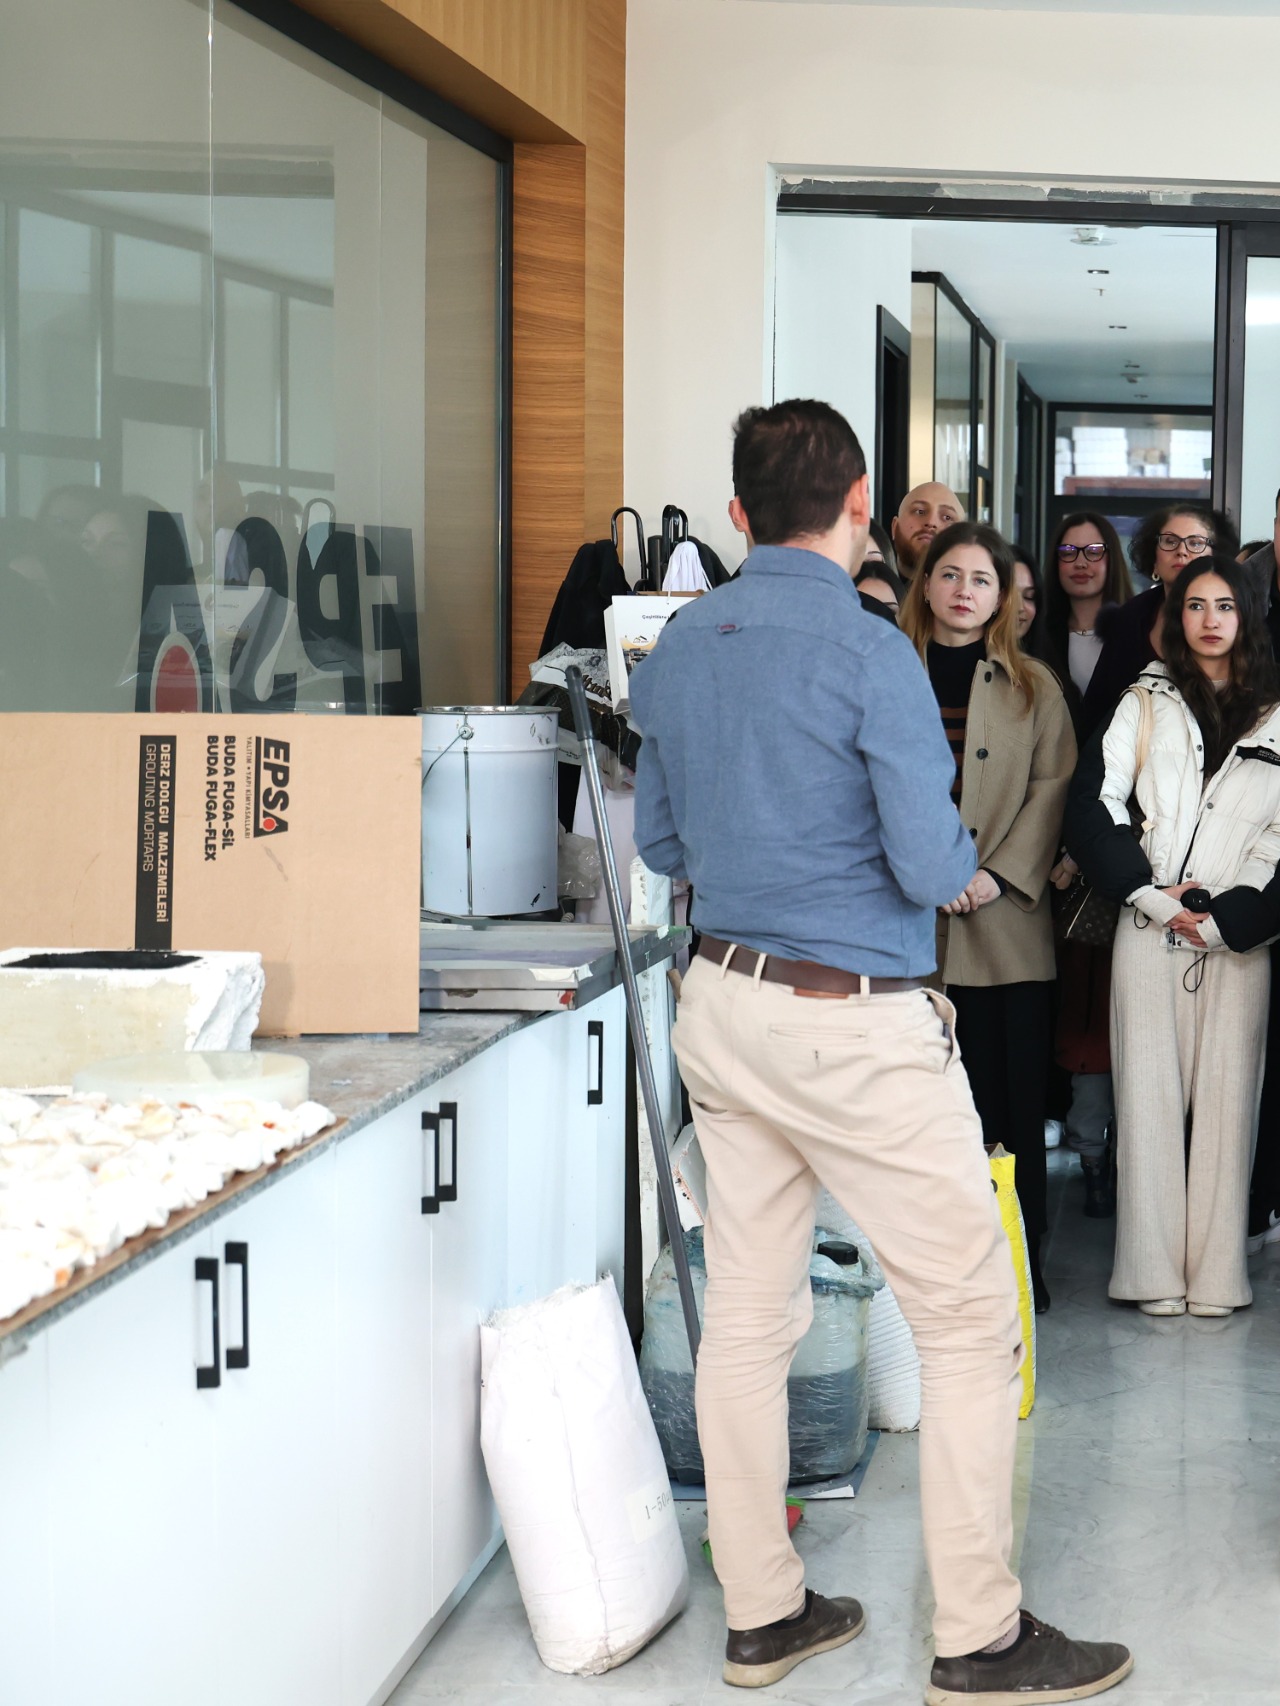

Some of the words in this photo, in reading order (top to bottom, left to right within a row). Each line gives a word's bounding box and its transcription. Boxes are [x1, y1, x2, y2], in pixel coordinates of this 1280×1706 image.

[144, 743, 157, 808] GROUTING
[159, 743, 171, 777] DERZ
[205, 735, 219, 777] BUDA
[222, 735, 236, 777] BUDA
[245, 736, 253, 765] YALITIM
[158, 780, 170, 824] DOLGU
[254, 736, 291, 839] EPSA
[142, 811, 156, 872] MORTARS
[204, 780, 218, 862] FUGA-FLEX
[156, 830, 170, 923] MALZEMELERİ
